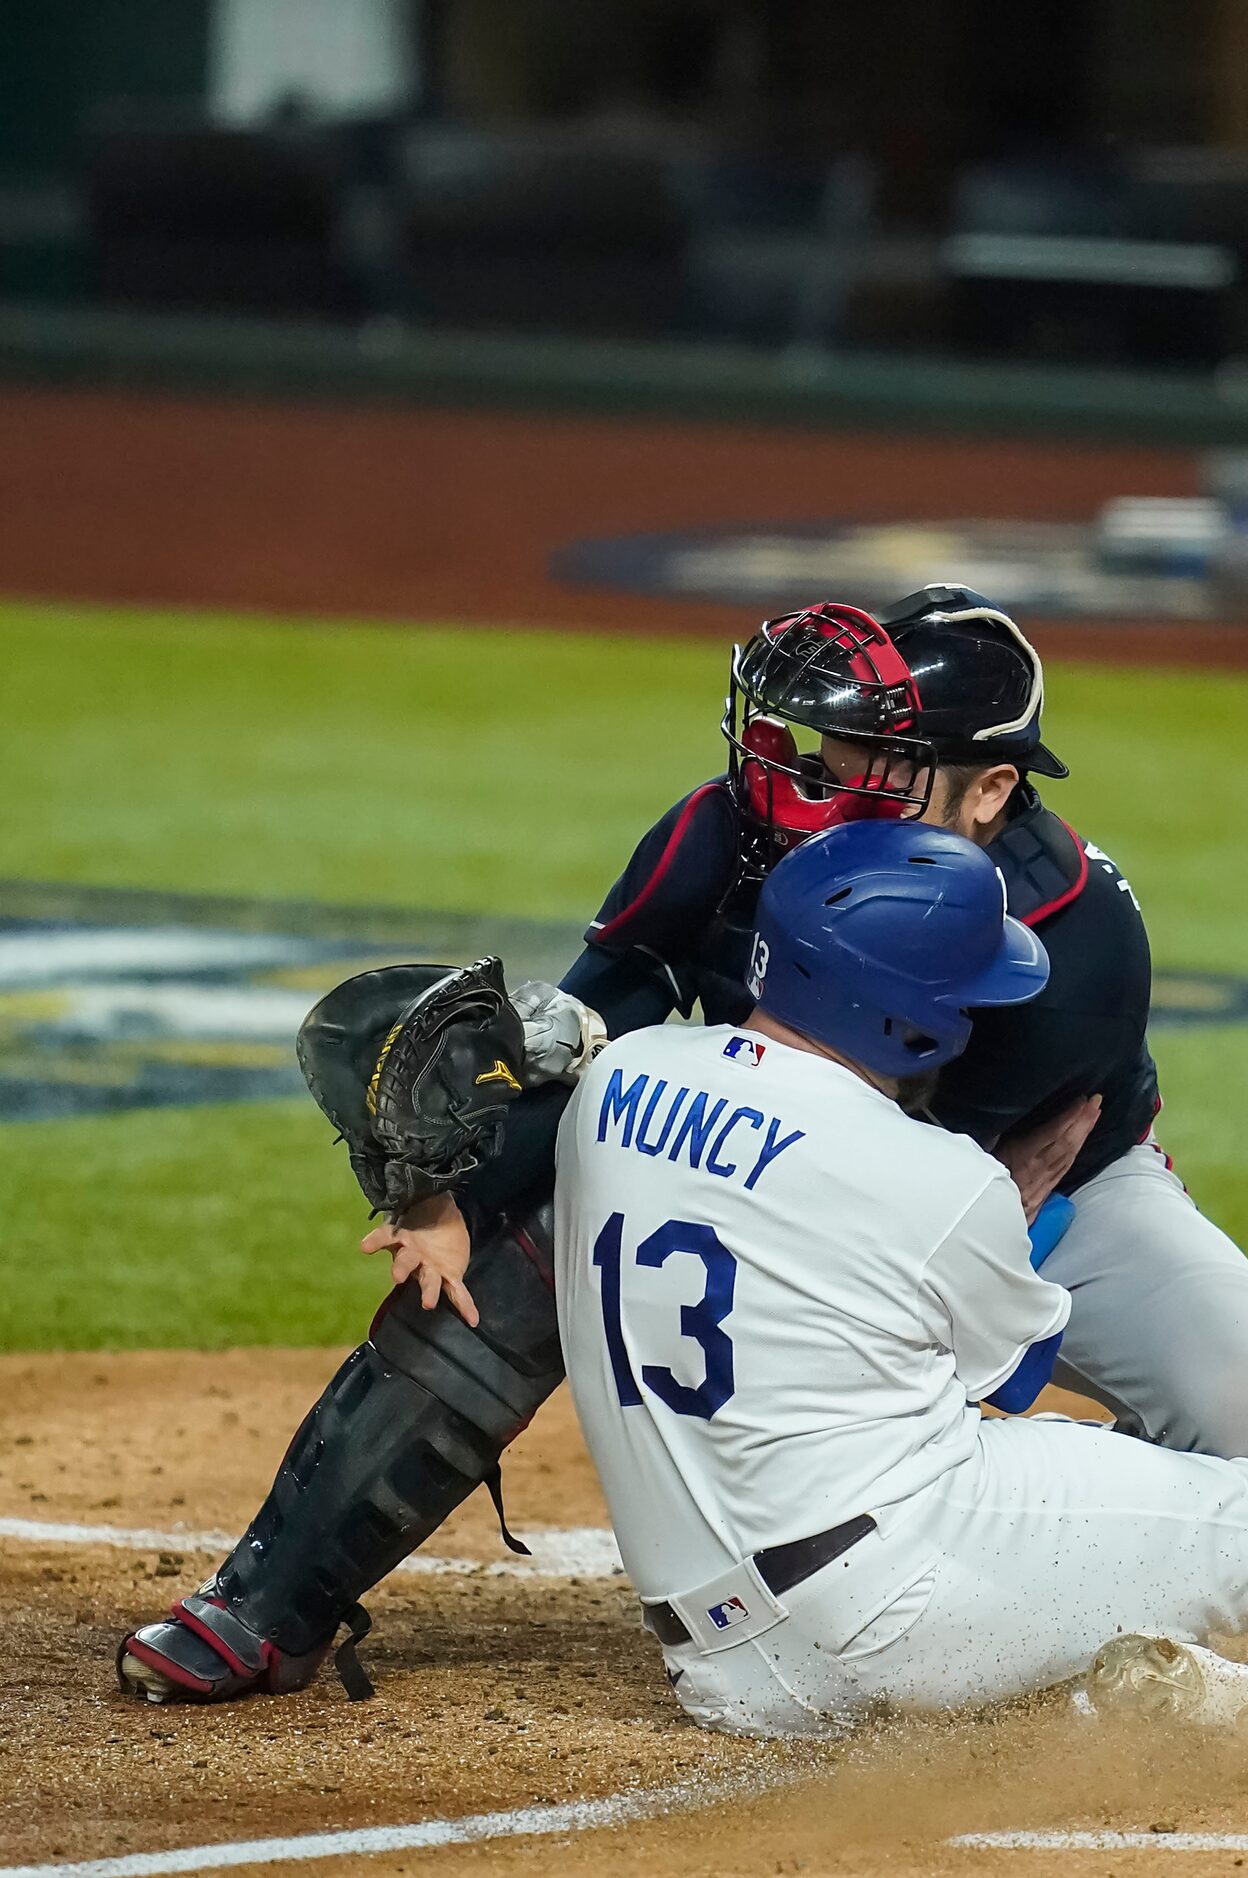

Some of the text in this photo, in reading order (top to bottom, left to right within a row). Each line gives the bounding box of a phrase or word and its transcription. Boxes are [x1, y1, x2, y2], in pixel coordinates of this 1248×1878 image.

[751, 932, 770, 979] 13
[596, 1069, 806, 1190] MUNCY
[593, 1211, 738, 1420] 13
